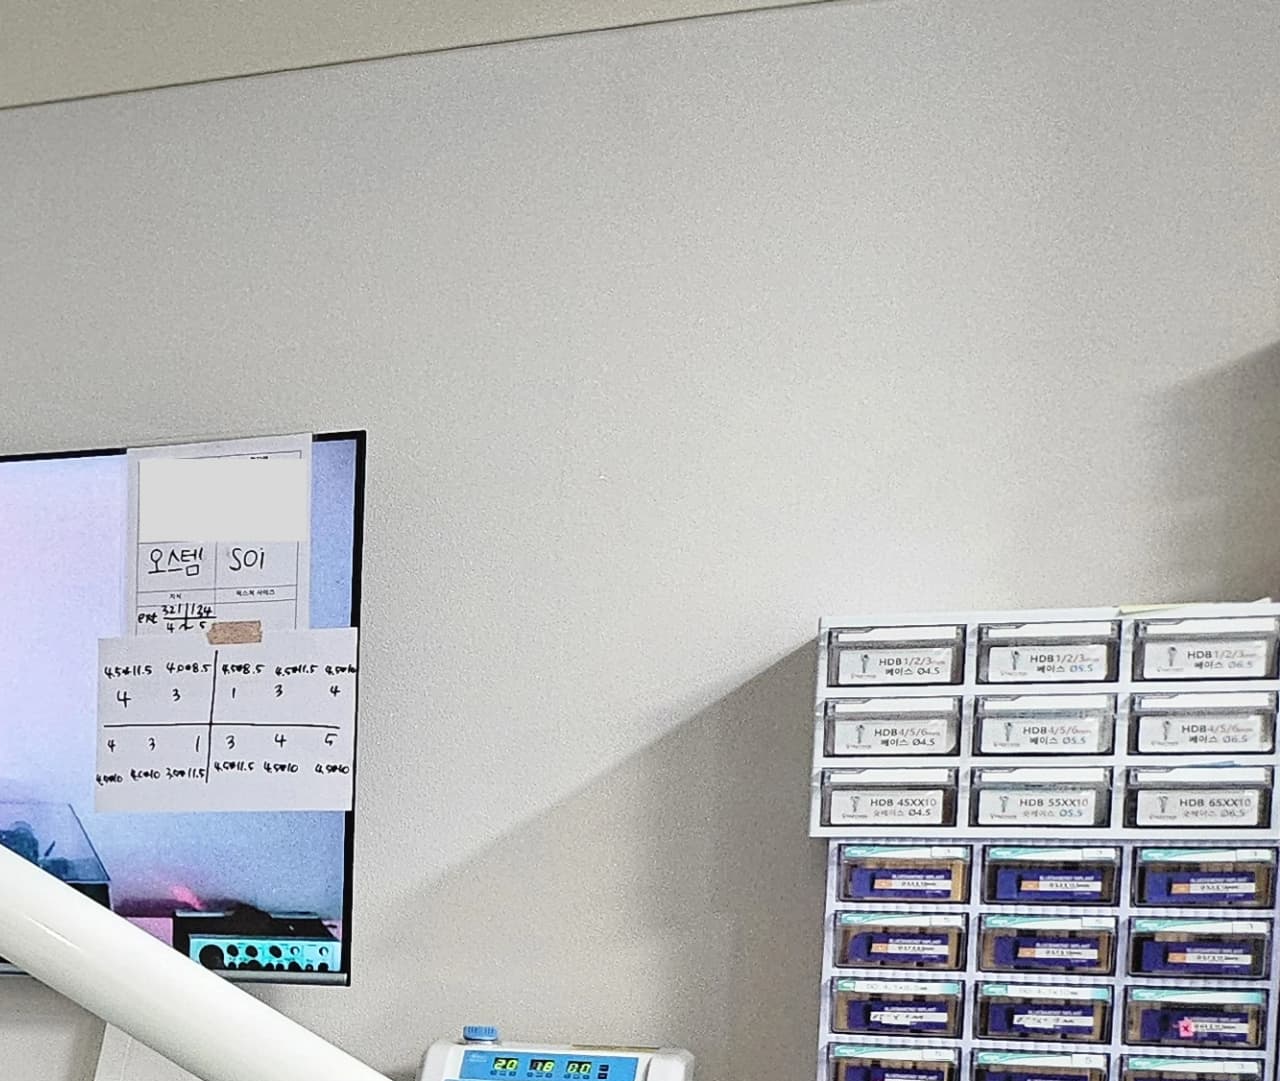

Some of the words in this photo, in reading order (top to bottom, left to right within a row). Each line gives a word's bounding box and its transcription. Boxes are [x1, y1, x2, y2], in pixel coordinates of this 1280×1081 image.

[148, 547, 203, 577] 오스템
[1030, 654, 1054, 664] HDB
[1187, 650, 1212, 660] HDB
[879, 657, 902, 667] HDB
[116, 690, 132, 709] 4
[172, 688, 181, 702] 3
[231, 687, 237, 699] 1
[274, 684, 283, 698] 3
[329, 685, 342, 698] 4
[874, 728, 898, 737] HDB
[1023, 726, 1047, 735] HDB
[1181, 725, 1207, 734] HDB
[106, 739, 117, 753] 4
[148, 737, 156, 751] 3
[225, 735, 236, 750] 3
[274, 733, 288, 749] 4
[324, 733, 338, 747] 5
[870, 798, 894, 808] HDB
[1019, 798, 1044, 808] HDB
[1179, 799, 1204, 808] HDB
[494, 1058, 517, 1071] 20
[567, 1062, 591, 1074] 00
